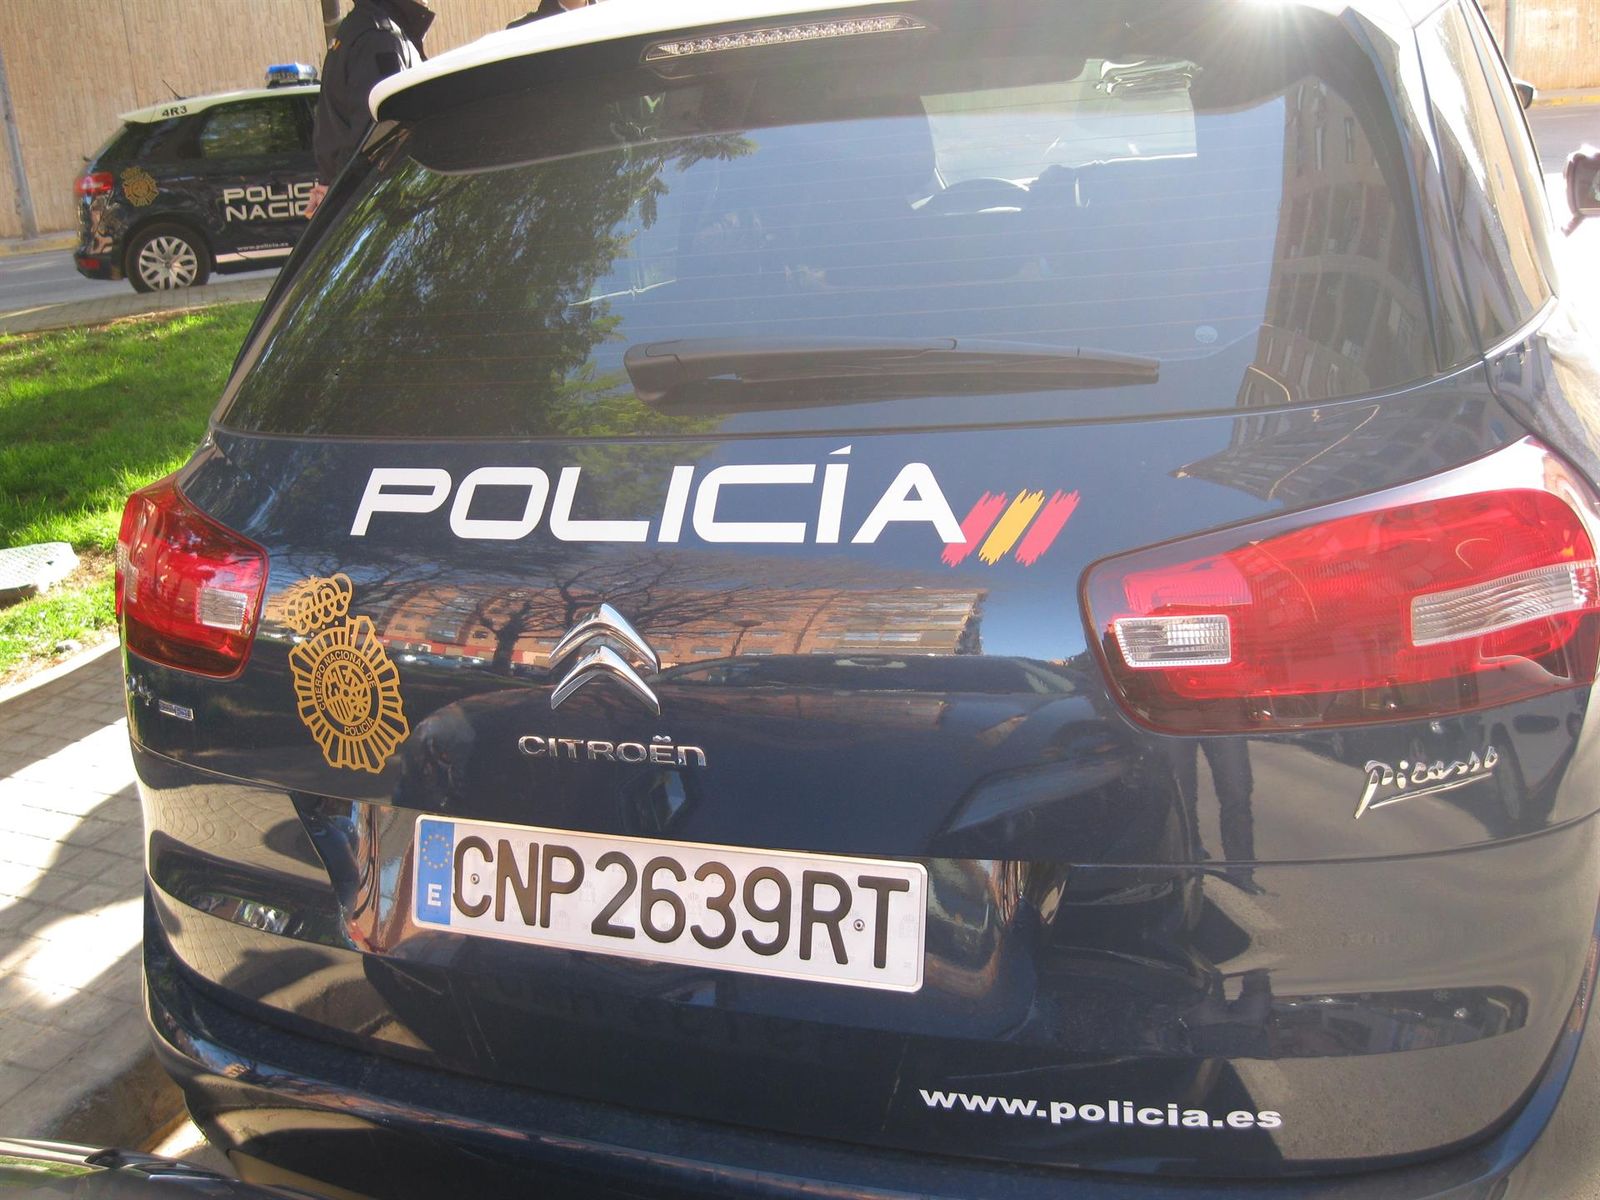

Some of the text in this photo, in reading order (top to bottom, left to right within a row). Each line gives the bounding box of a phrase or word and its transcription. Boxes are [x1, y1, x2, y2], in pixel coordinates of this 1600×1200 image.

[161, 105, 188, 117] 4R3
[350, 445, 967, 543] POLICÍA
[325, 650, 366, 672] NACIONAL
[366, 672, 377, 689] DE
[426, 883, 442, 906] E
[918, 1088, 1283, 1128] www.policia.es
